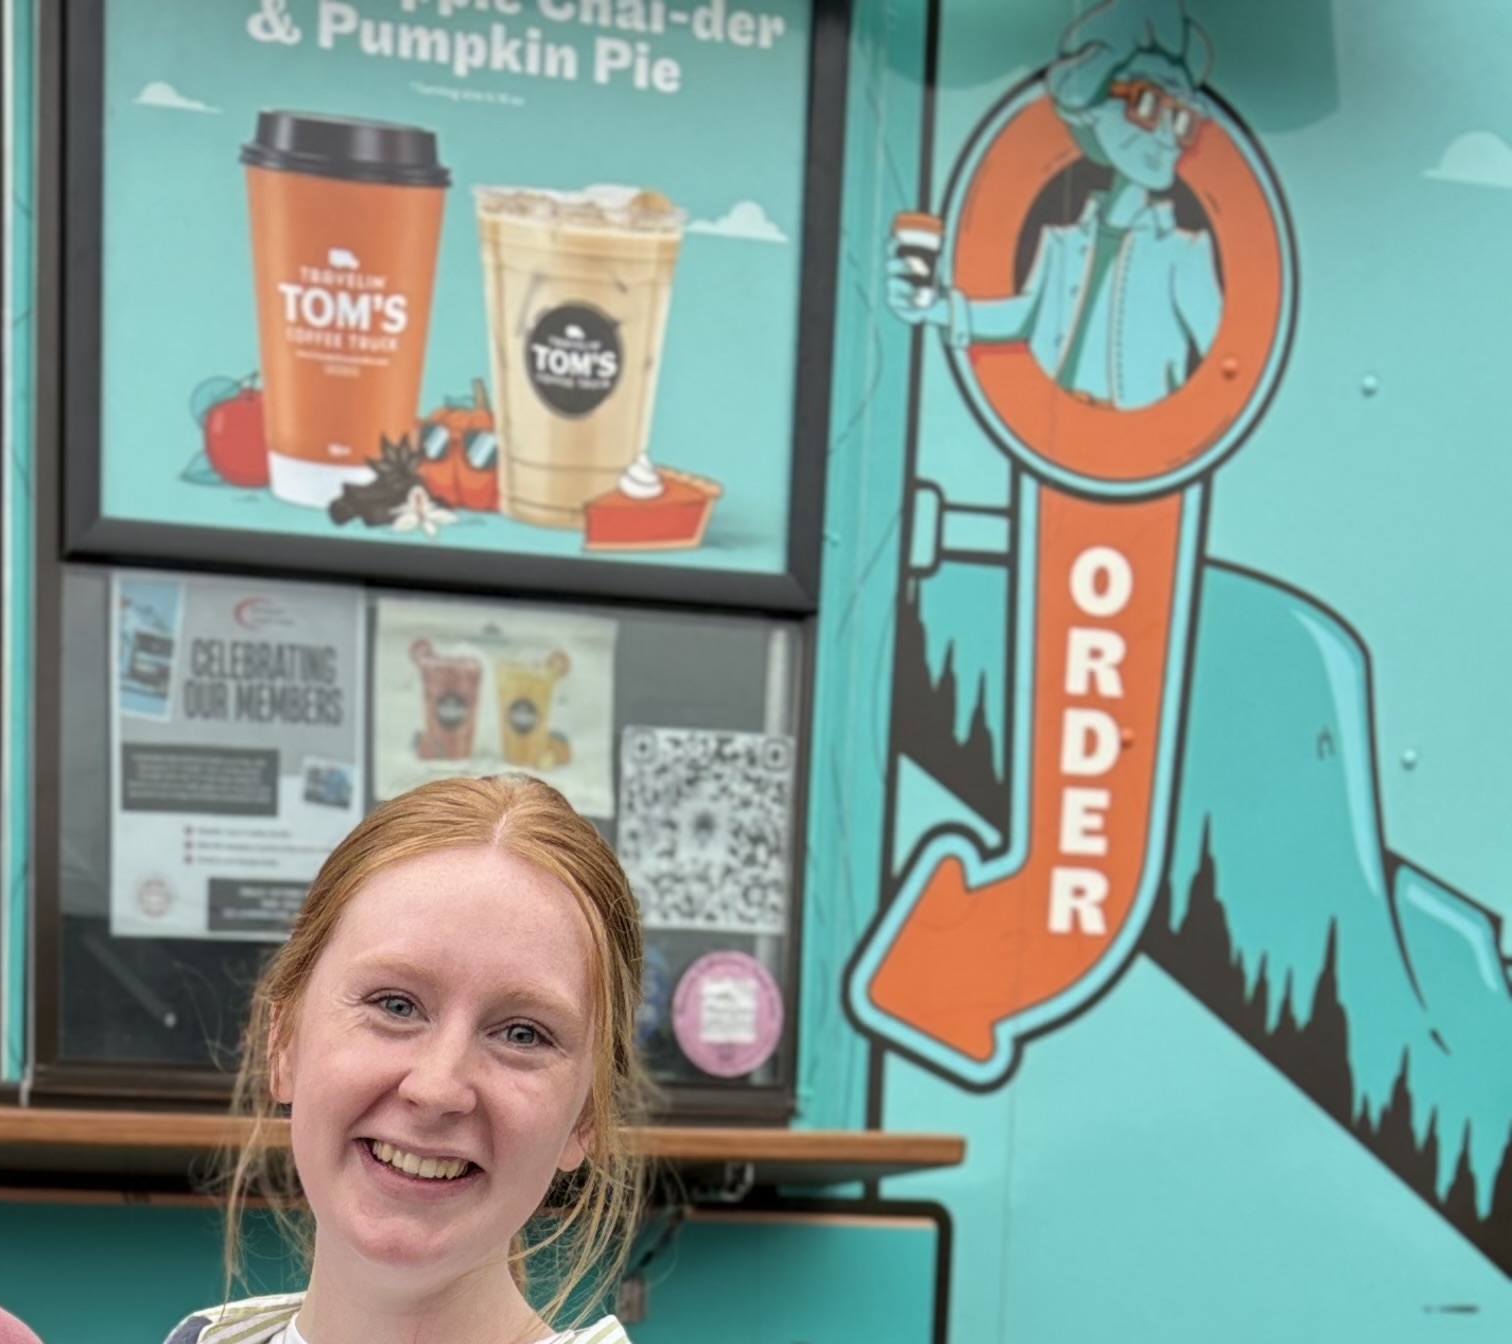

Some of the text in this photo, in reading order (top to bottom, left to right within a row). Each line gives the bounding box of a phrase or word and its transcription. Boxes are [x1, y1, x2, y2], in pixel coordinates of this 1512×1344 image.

[247, 0, 682, 93] & Pumpkin Pie
[278, 282, 408, 333] TOM'S
[531, 344, 618, 378] TOM'S
[191, 637, 336, 685] CELEBRATING
[184, 679, 343, 727] OUR MEMBERS
[1047, 545, 1134, 935] ORDER
